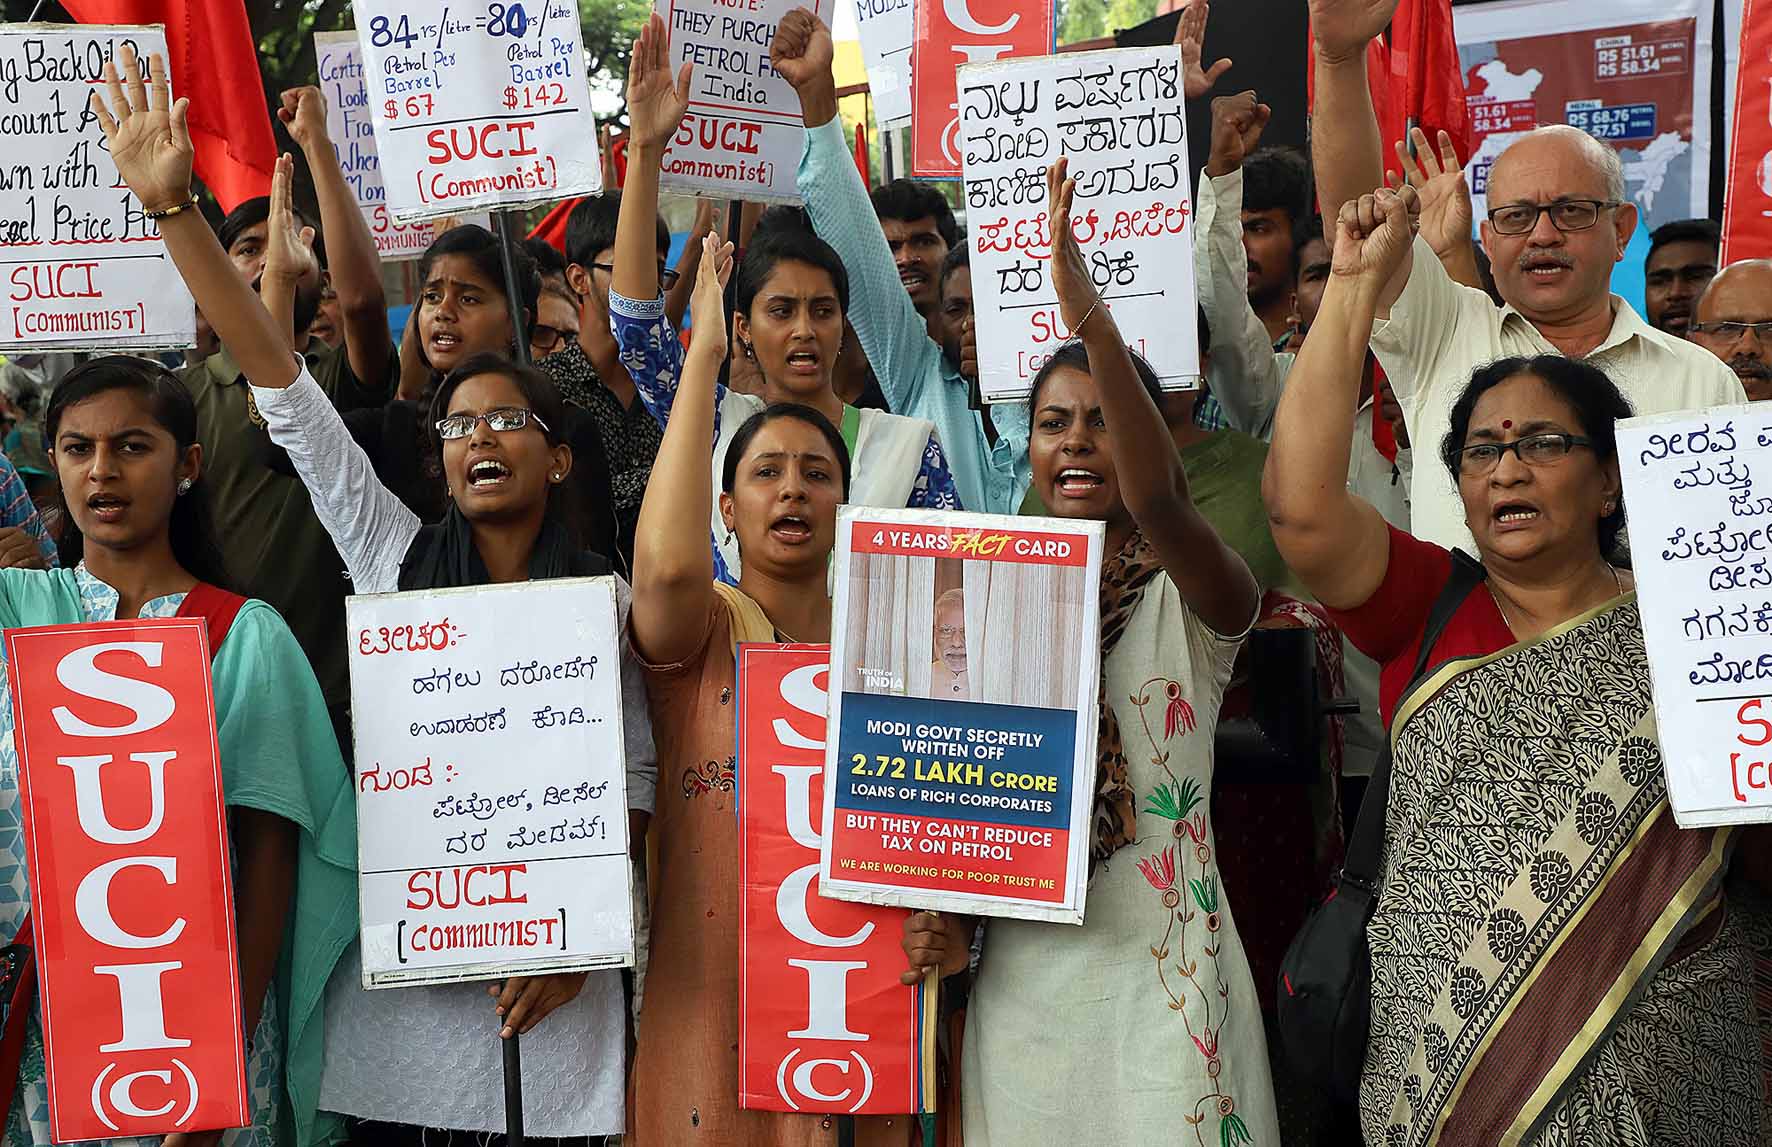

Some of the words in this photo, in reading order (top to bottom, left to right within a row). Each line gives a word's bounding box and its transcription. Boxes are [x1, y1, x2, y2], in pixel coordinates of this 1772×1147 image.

[674, 9, 716, 35] THEY
[722, 17, 776, 46] PURCH
[23, 39, 86, 82] Back
[384, 52, 428, 76] Petrol
[434, 50, 456, 68] Per
[508, 41, 542, 62] Petrol
[551, 38, 574, 56] Per
[682, 42, 752, 76] PETROL
[1598, 50, 1617, 62] RS
[1622, 46, 1655, 60] 51.61
[510, 58, 571, 84] Barrel
[1598, 63, 1617, 76] RS
[1621, 58, 1660, 74] 58.34
[385, 70, 442, 94] Barrel
[701, 74, 768, 104] India
[1568, 113, 1588, 126] RS
[1592, 109, 1630, 124] 68.76
[427, 122, 537, 164] SUCI
[675, 114, 762, 154] SUCI
[42, 140, 98, 188] with
[417, 156, 558, 204] [Communist]
[51, 195, 112, 242] Price
[10, 262, 102, 300] SUCI
[872, 532, 884, 546] 4
[890, 532, 948, 550] YEARS
[950, 533, 1016, 557] FACT
[1014, 539, 1071, 558] CARD
[413, 667, 481, 694] ಹಗಲು
[867, 676, 904, 688] INDIA
[867, 720, 910, 736] MODI
[916, 724, 962, 741] GOVT
[966, 728, 1044, 748] SECRETLY
[902, 739, 968, 757] WRITTEN
[974, 745, 1004, 760] OFF
[852, 754, 906, 778] 2.72
[914, 760, 984, 785] LAKH
[990, 772, 1058, 792] CRORE
[852, 784, 895, 798] LOANS
[899, 787, 917, 800] OF
[921, 790, 955, 804] RICH
[959, 792, 1052, 812] CORPORATES
[446, 828, 488, 854] ದರ
[846, 814, 876, 830] BUT
[881, 818, 921, 835] THEY
[926, 822, 980, 840] CAN'T
[984, 826, 1052, 848] REDUCE
[881, 834, 914, 850] TAX
[920, 839, 946, 853] ON
[952, 842, 1014, 861] PETROL
[406, 864, 528, 910] SUCI
[840, 858, 856, 869] WE
[860, 860, 880, 872] ARE
[884, 863, 938, 878] WORKING
[942, 868, 962, 880] FOR
[968, 871, 1000, 884] POOR
[1003, 875, 1035, 888] TRUST
[1039, 879, 1055, 890] ME
